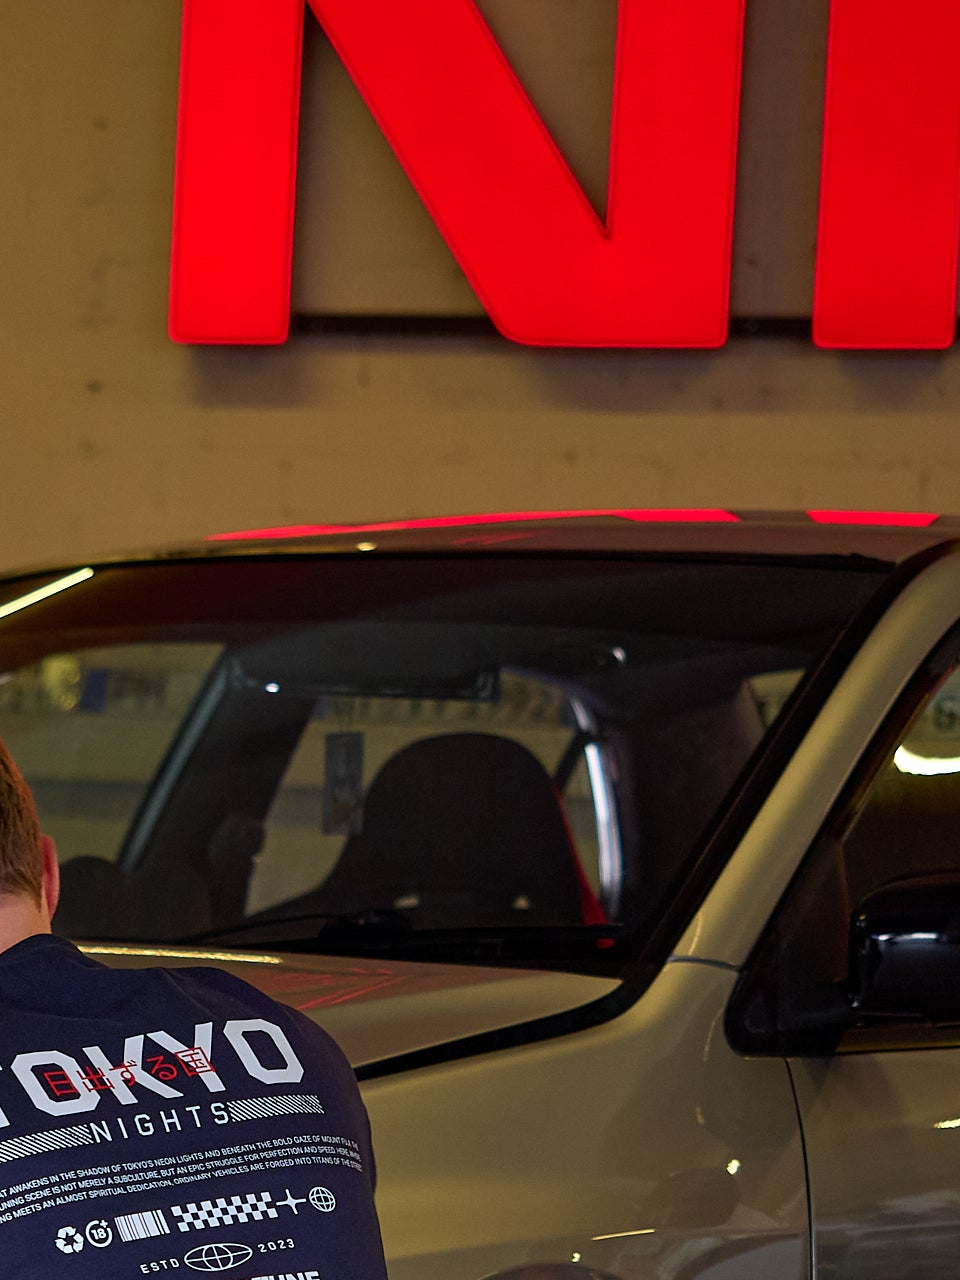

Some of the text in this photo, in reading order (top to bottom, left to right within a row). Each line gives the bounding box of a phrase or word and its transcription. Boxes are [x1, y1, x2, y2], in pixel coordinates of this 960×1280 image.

[43, 1046, 216, 1097] 日出ずる国
[89, 1102, 230, 1143] NIGHTS
[9, 1177, 50, 1195] AWAKENS
[49, 1174, 60, 1184] IN
[59, 1170, 77, 1181] THE
[76, 1165, 111, 1178] SHADOW
[111, 1164, 122, 1173] OF
[122, 1159, 154, 1171] TOKYO'S
[153, 1157, 177, 1167] NEON
[177, 1152, 204, 1163] LIGHTS
[204, 1149, 221, 1159] AND
[221, 1143, 257, 1156] BENEATH
[257, 1140, 273, 1149] THE
[272, 1137, 293, 1147] BOLD
[293, 1135, 312, 1144] GAZE
[312, 1135, 320, 1143] OF
[12, 1203, 43, 1218] MEETS
[43, 1199, 55, 1209] AN
[56, 1191, 88, 1206] ALMOST
[89, 1187, 128, 1199] SPIRITUAL
[127, 1180, 174, 1193] DEDICATION,
[174, 1172, 212, 1185] ORDINARY
[212, 1165, 250, 1177] VEHICLES
[250, 1161, 265, 1171] ARE
[265, 1158, 295, 1169] FORGED
[294, 1156, 312, 1165] INTO
[25, 1188, 53, 1202] SCENE
[52, 1186, 61, 1194] IS
[60, 1183, 78, 1192] NOT
[78, 1178, 107, 1189] MERELY
[107, 1177, 114, 1185] A
[160, 1167, 175, 1177] BUT
[176, 1165, 188, 1174] AN
[188, 1162, 205, 1173] EPIC
[205, 1154, 244, 1169] STRUGGLE
[243, 1152, 260, 1163] FOR
[260, 1147, 304, 1160] PERFECTION
[303, 1145, 318, 1153] AND
[140, 1238, 295, 1274] ESTD 2023
